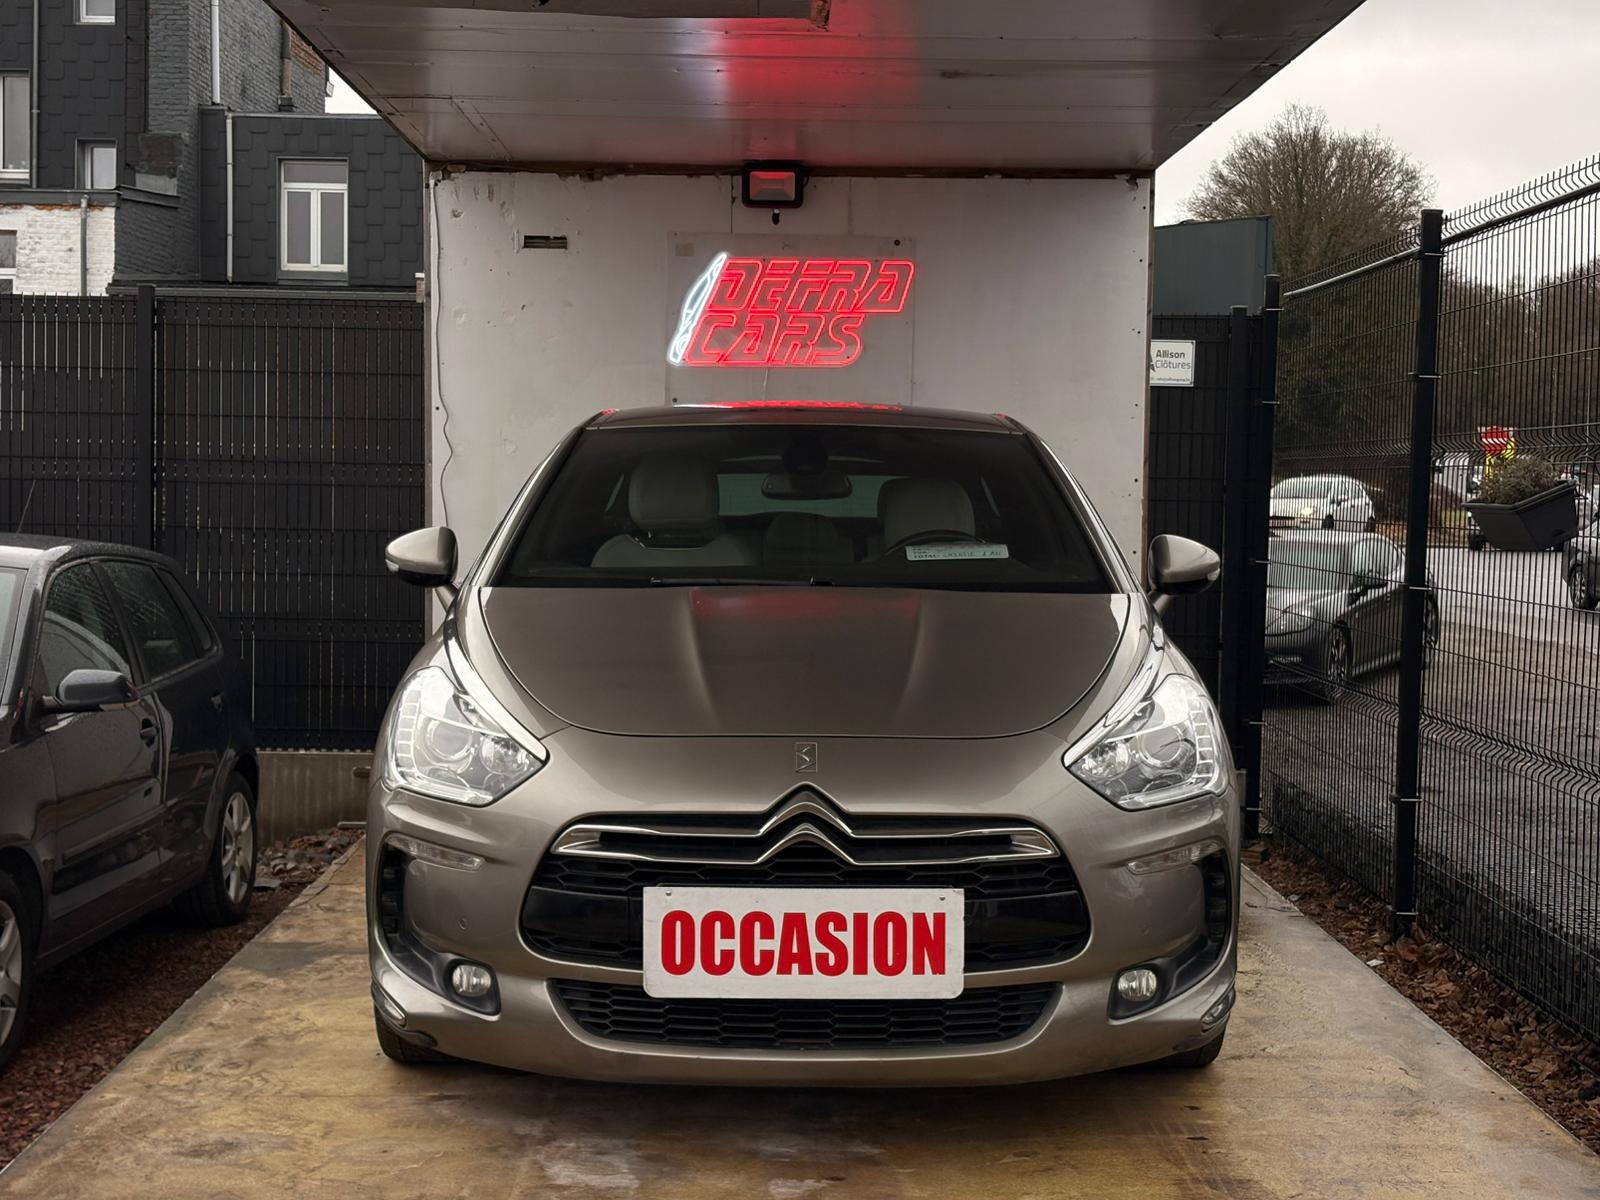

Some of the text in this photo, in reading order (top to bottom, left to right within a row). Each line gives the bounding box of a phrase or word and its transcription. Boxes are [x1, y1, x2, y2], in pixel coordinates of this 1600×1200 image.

[707, 258, 914, 313] DEFRA
[686, 312, 866, 367] CARS
[1155, 360, 1191, 369] Clôtures
[1156, 350, 1185, 358] Allison
[661, 910, 946, 976] OCCASION
